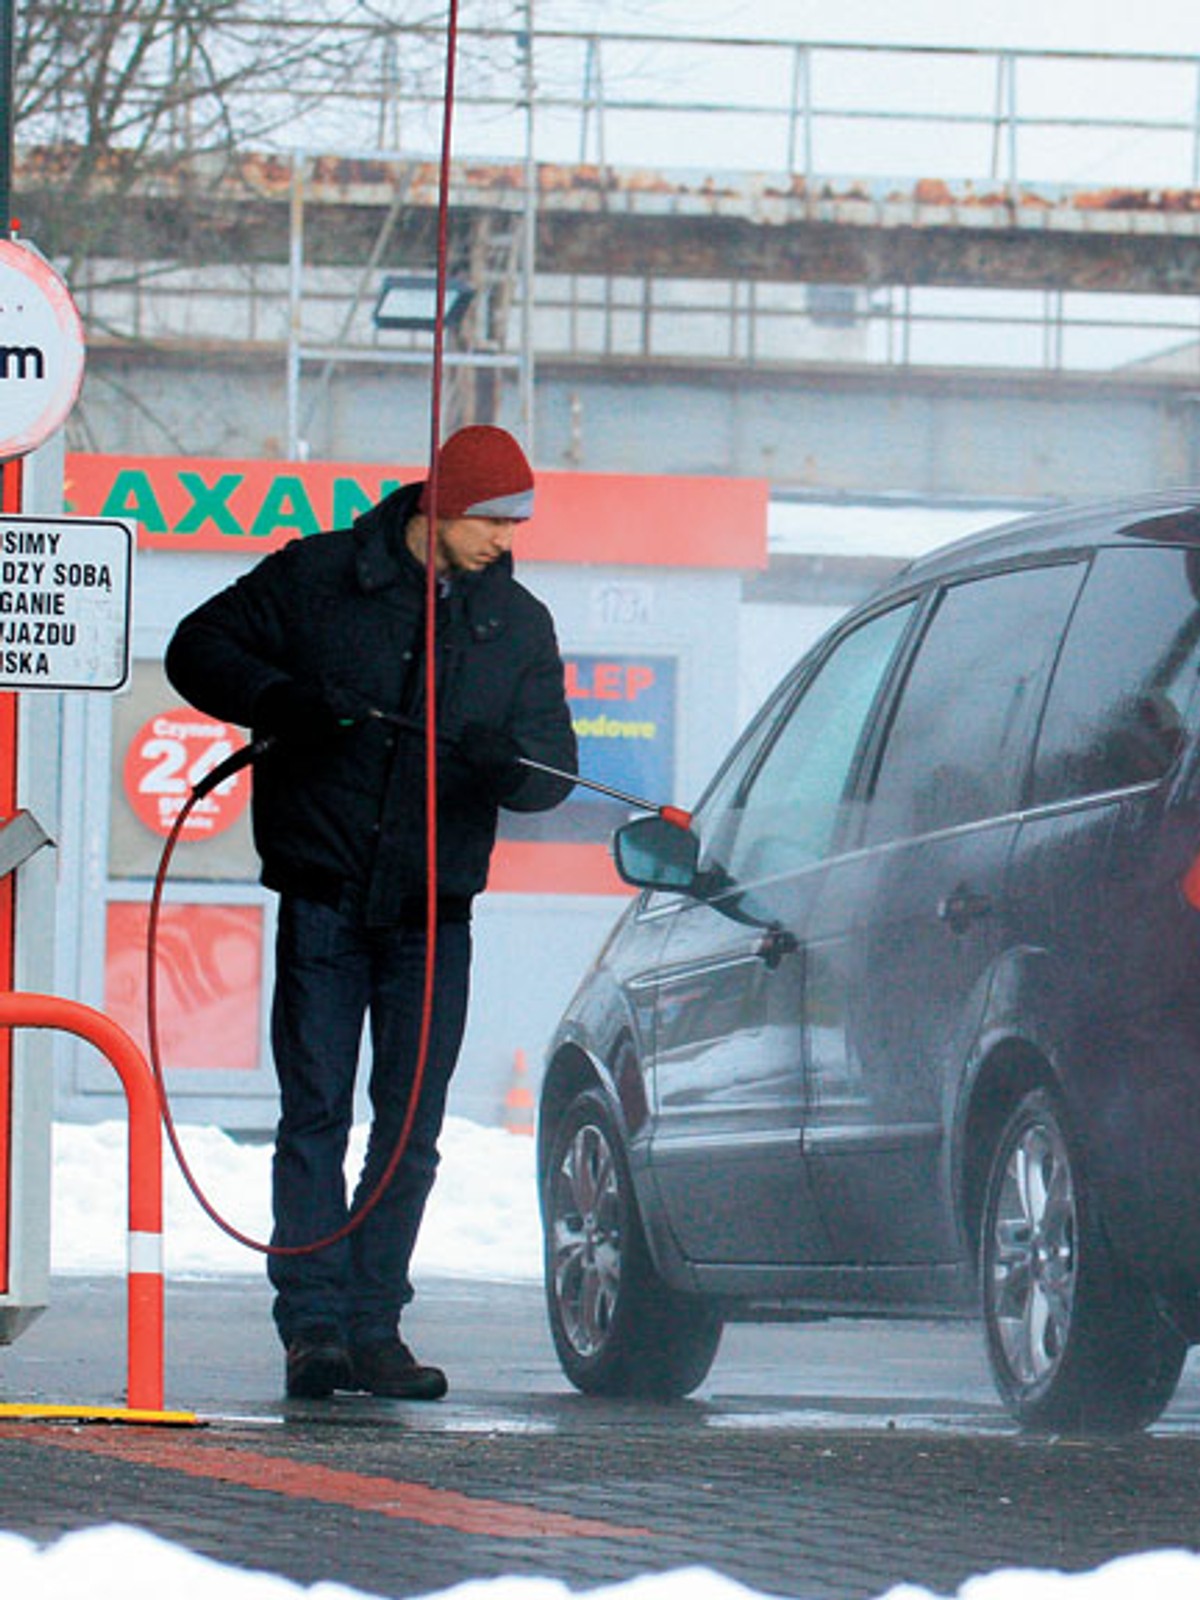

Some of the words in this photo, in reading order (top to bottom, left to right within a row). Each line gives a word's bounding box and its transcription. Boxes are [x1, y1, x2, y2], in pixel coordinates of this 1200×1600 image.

[0, 531, 61, 555] SIMY
[3, 561, 45, 584] DZY
[53, 563, 112, 592] SOBĄ
[0, 591, 65, 615] GANIE
[0, 622, 76, 645] JAZDU
[0, 651, 49, 675] SKA
[571, 715, 657, 739] odowe
